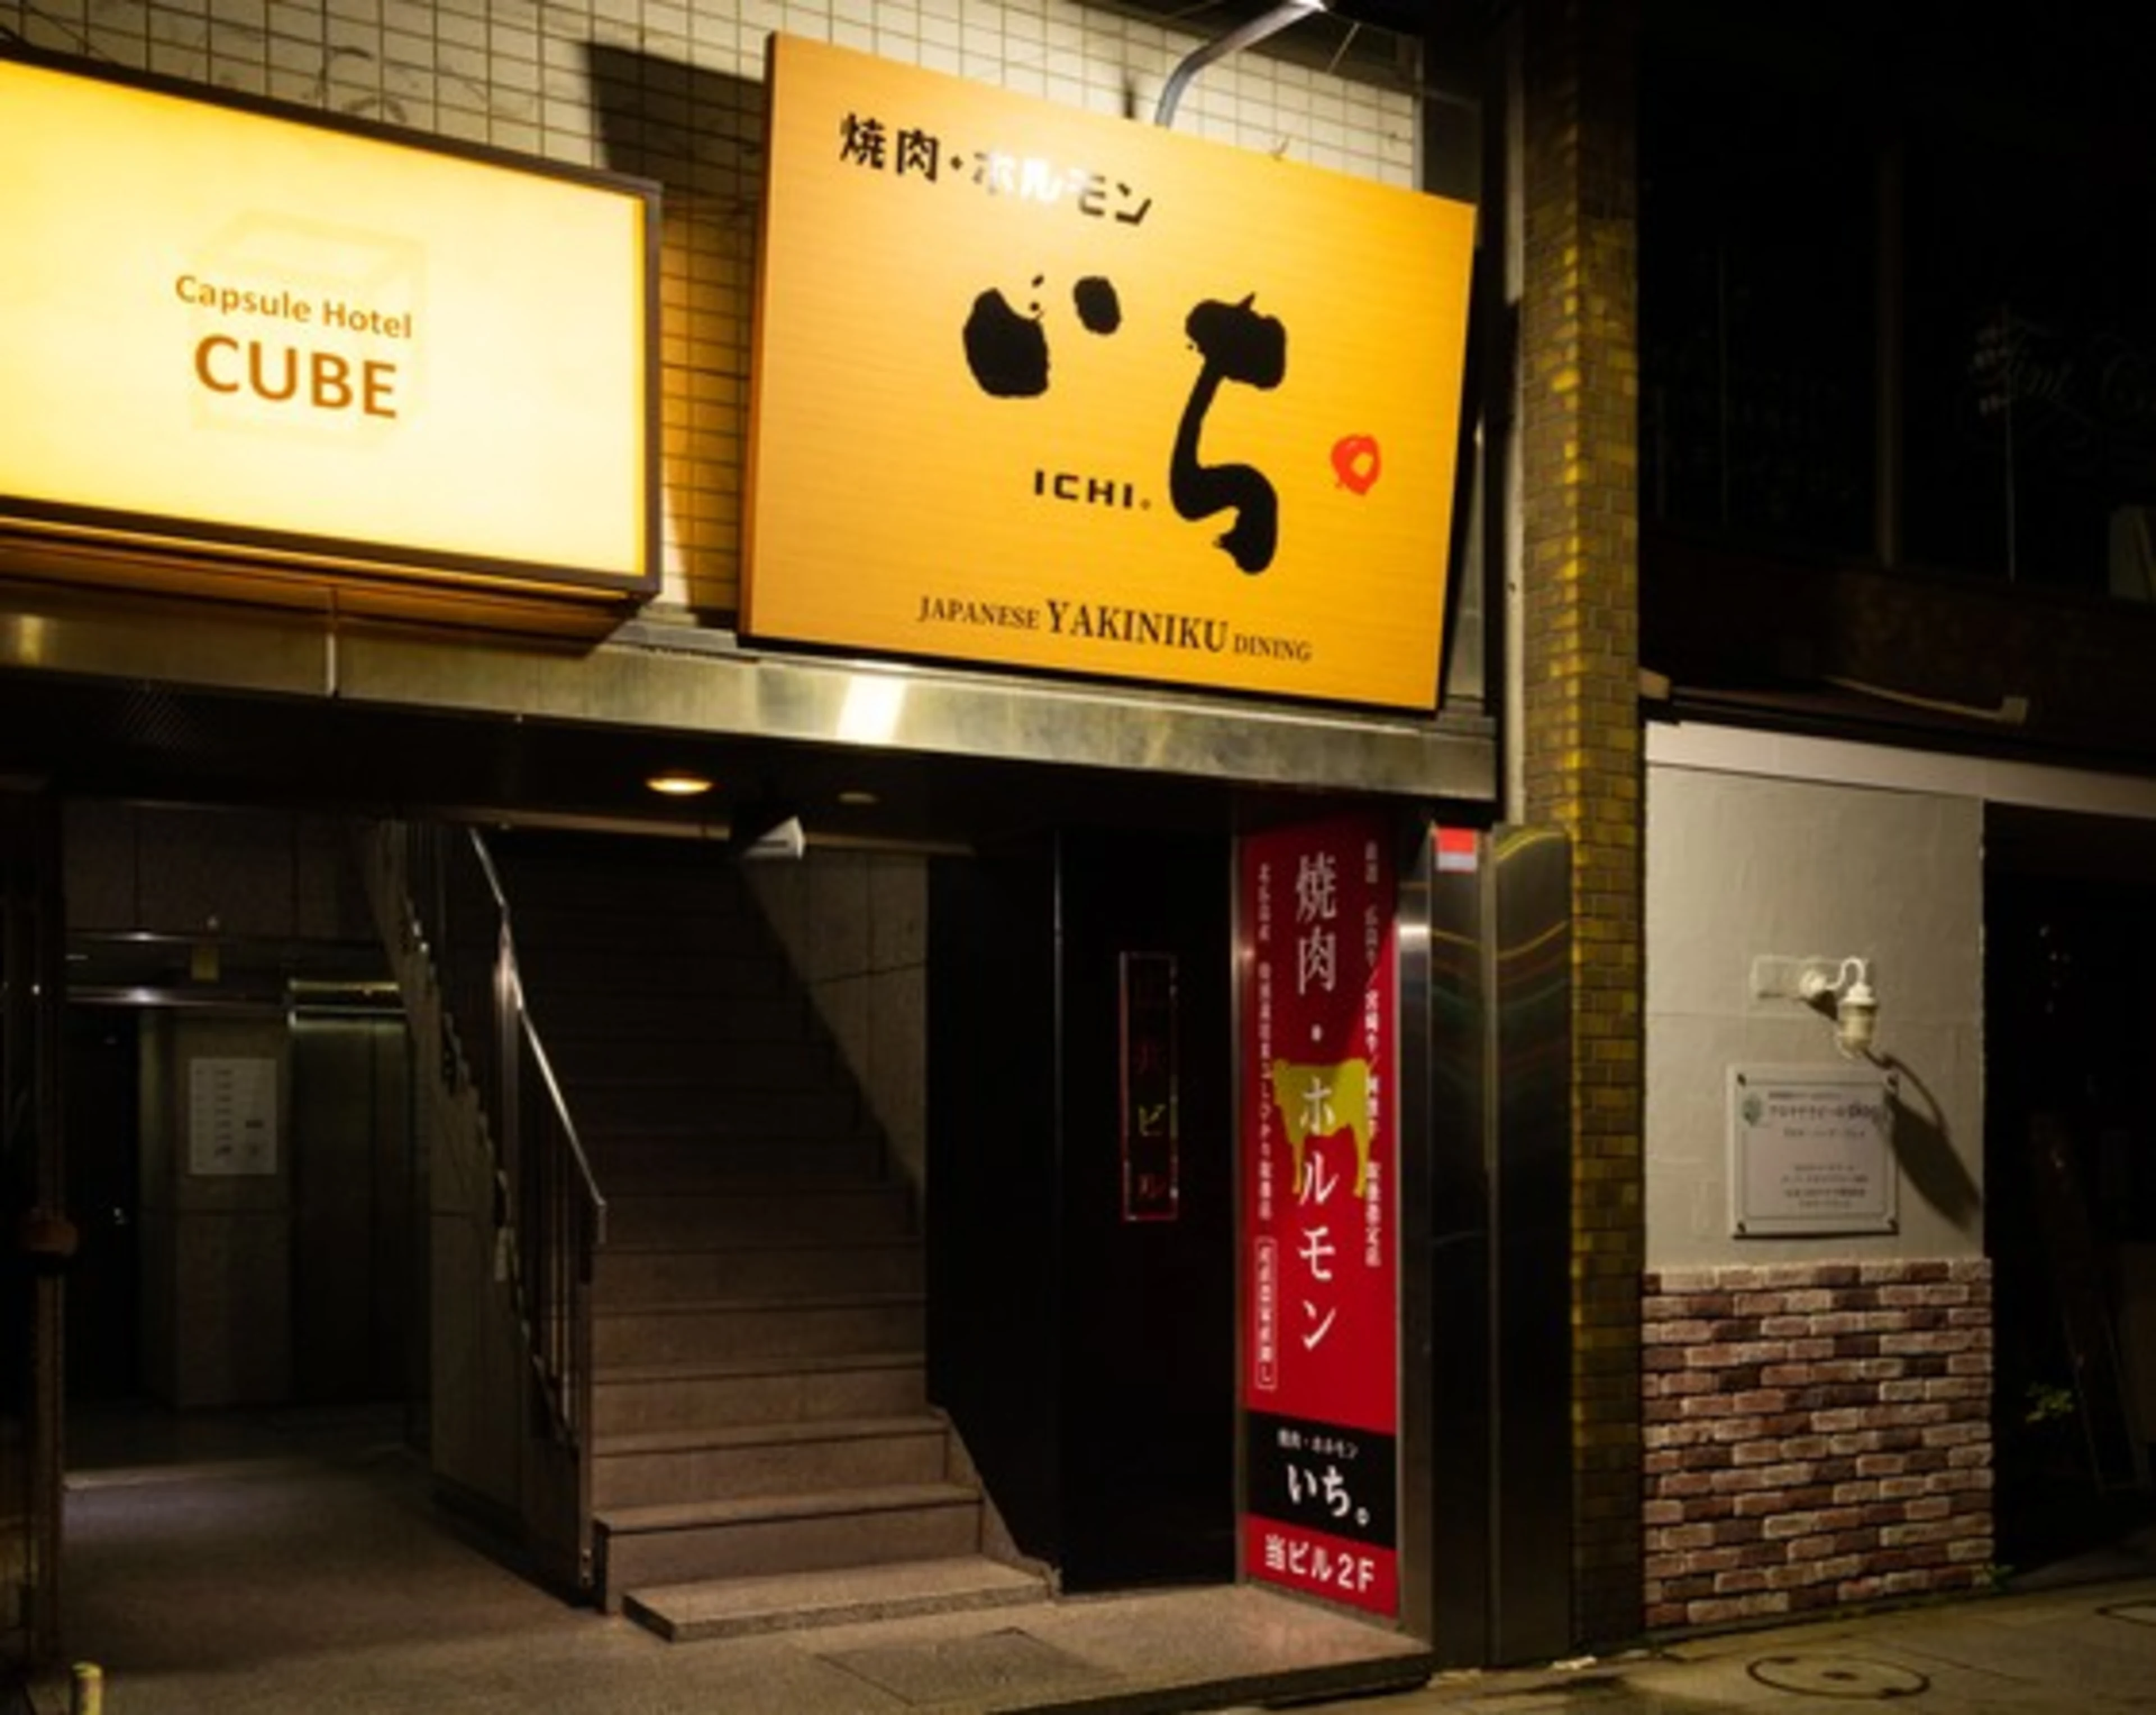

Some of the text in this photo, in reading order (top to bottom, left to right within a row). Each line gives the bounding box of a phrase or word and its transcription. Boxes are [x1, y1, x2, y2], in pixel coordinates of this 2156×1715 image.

[175, 274, 412, 339] Capsule Hotel
[194, 334, 398, 419] CUBE
[917, 595, 1313, 663] JAPANESE YAKINIKU DINING
[1296, 851, 1340, 1351] 焼肉・ホルモン
[1264, 1534, 1375, 1592] 当ビル2F
